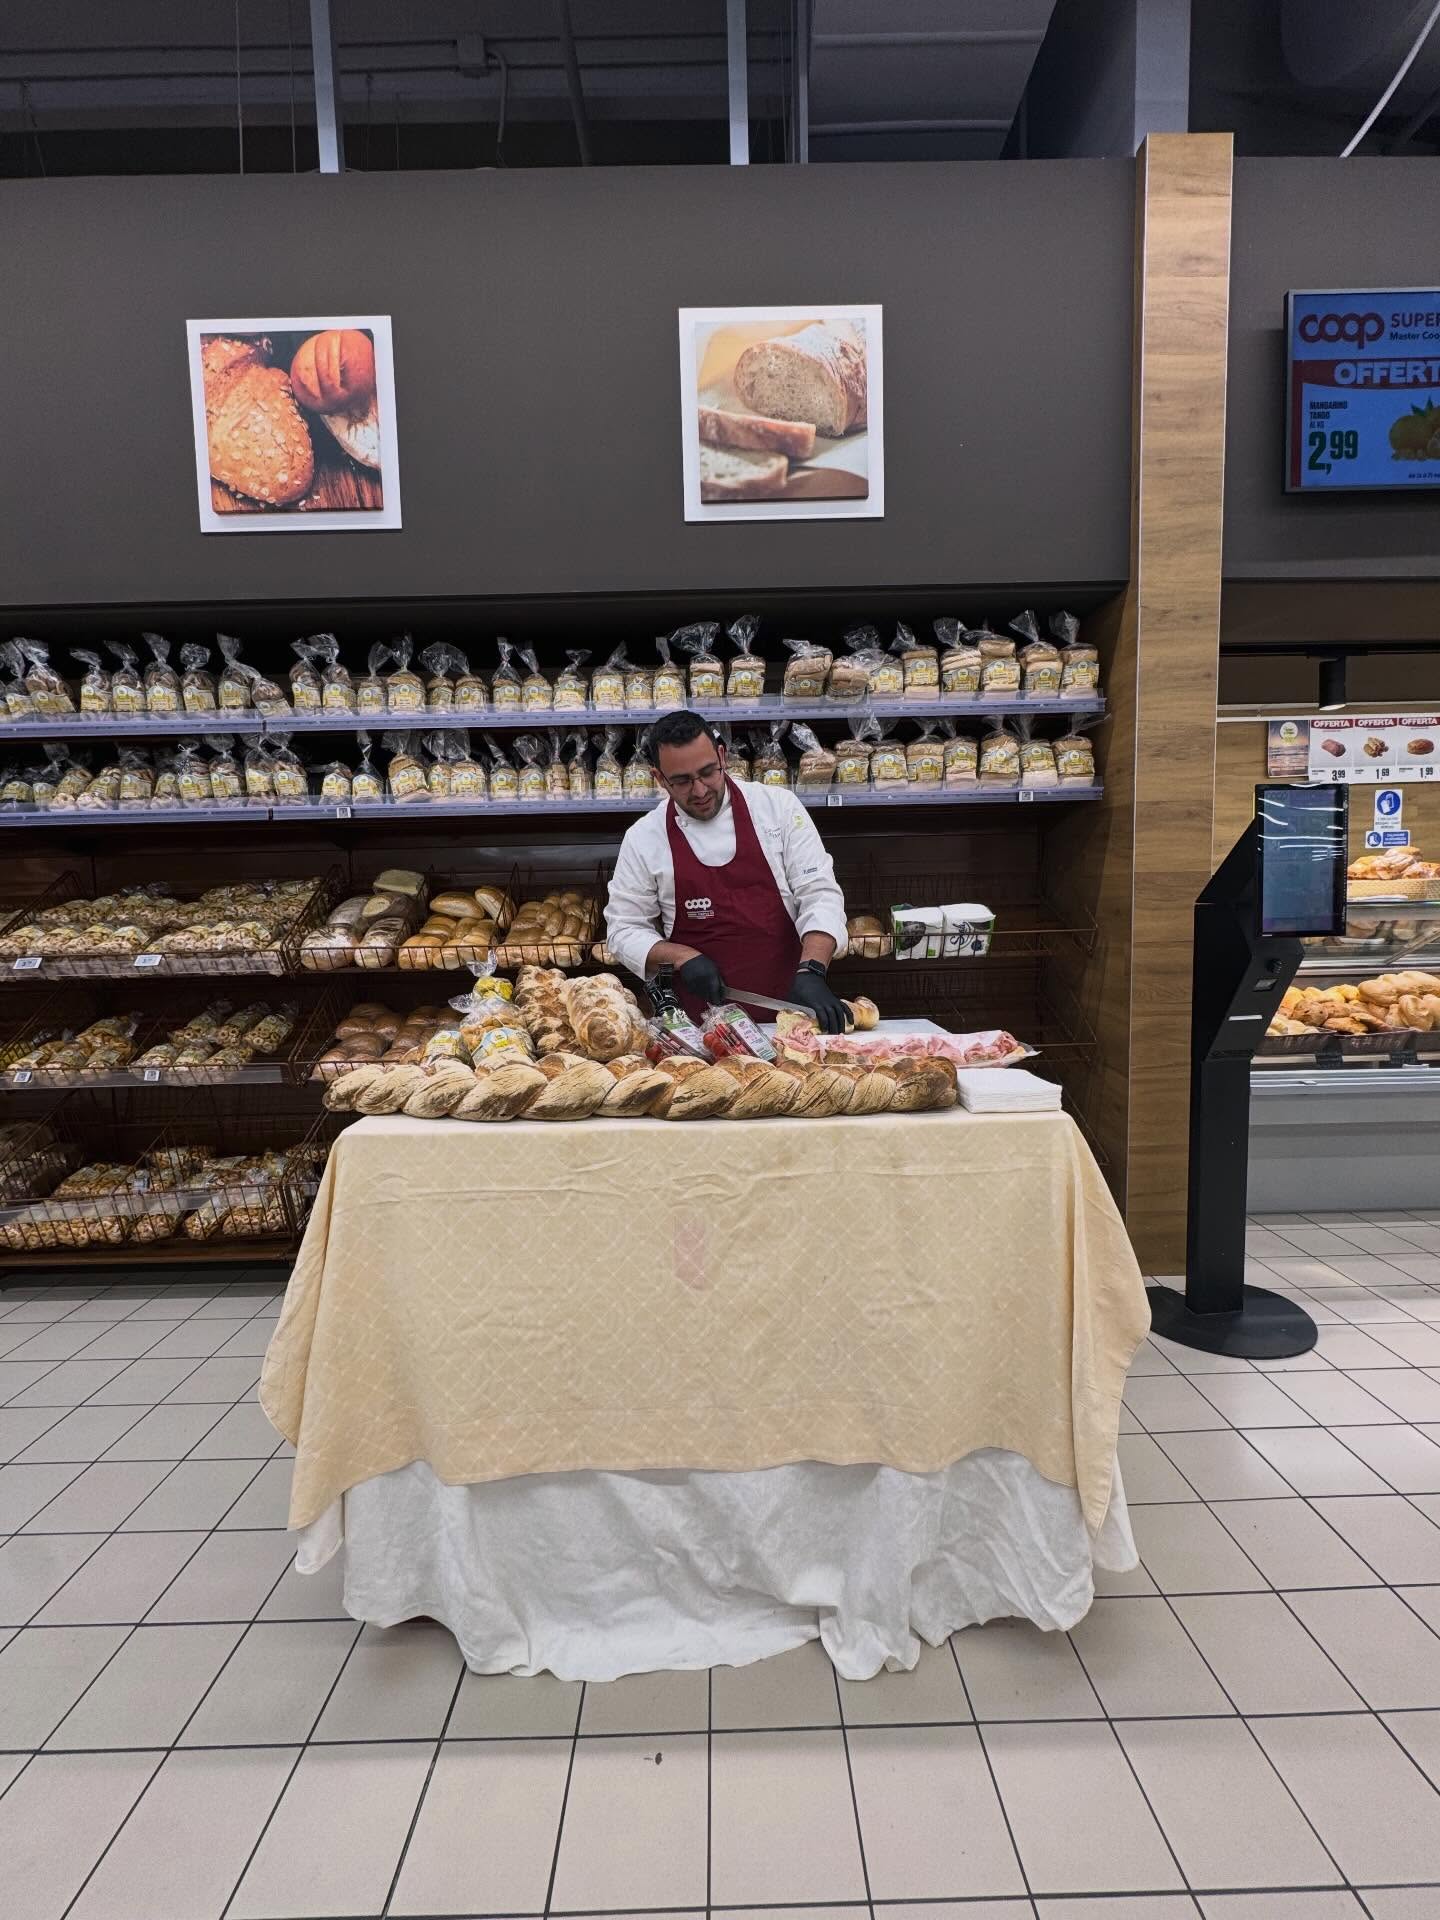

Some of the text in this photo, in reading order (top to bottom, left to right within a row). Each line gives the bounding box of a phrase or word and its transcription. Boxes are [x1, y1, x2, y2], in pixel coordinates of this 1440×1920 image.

[1299, 312, 1385, 349] coop
[1313, 719, 1350, 728] OFFERTA
[1357, 718, 1394, 727] OFFERTA
[1401, 717, 1438, 726] OFFERTA
